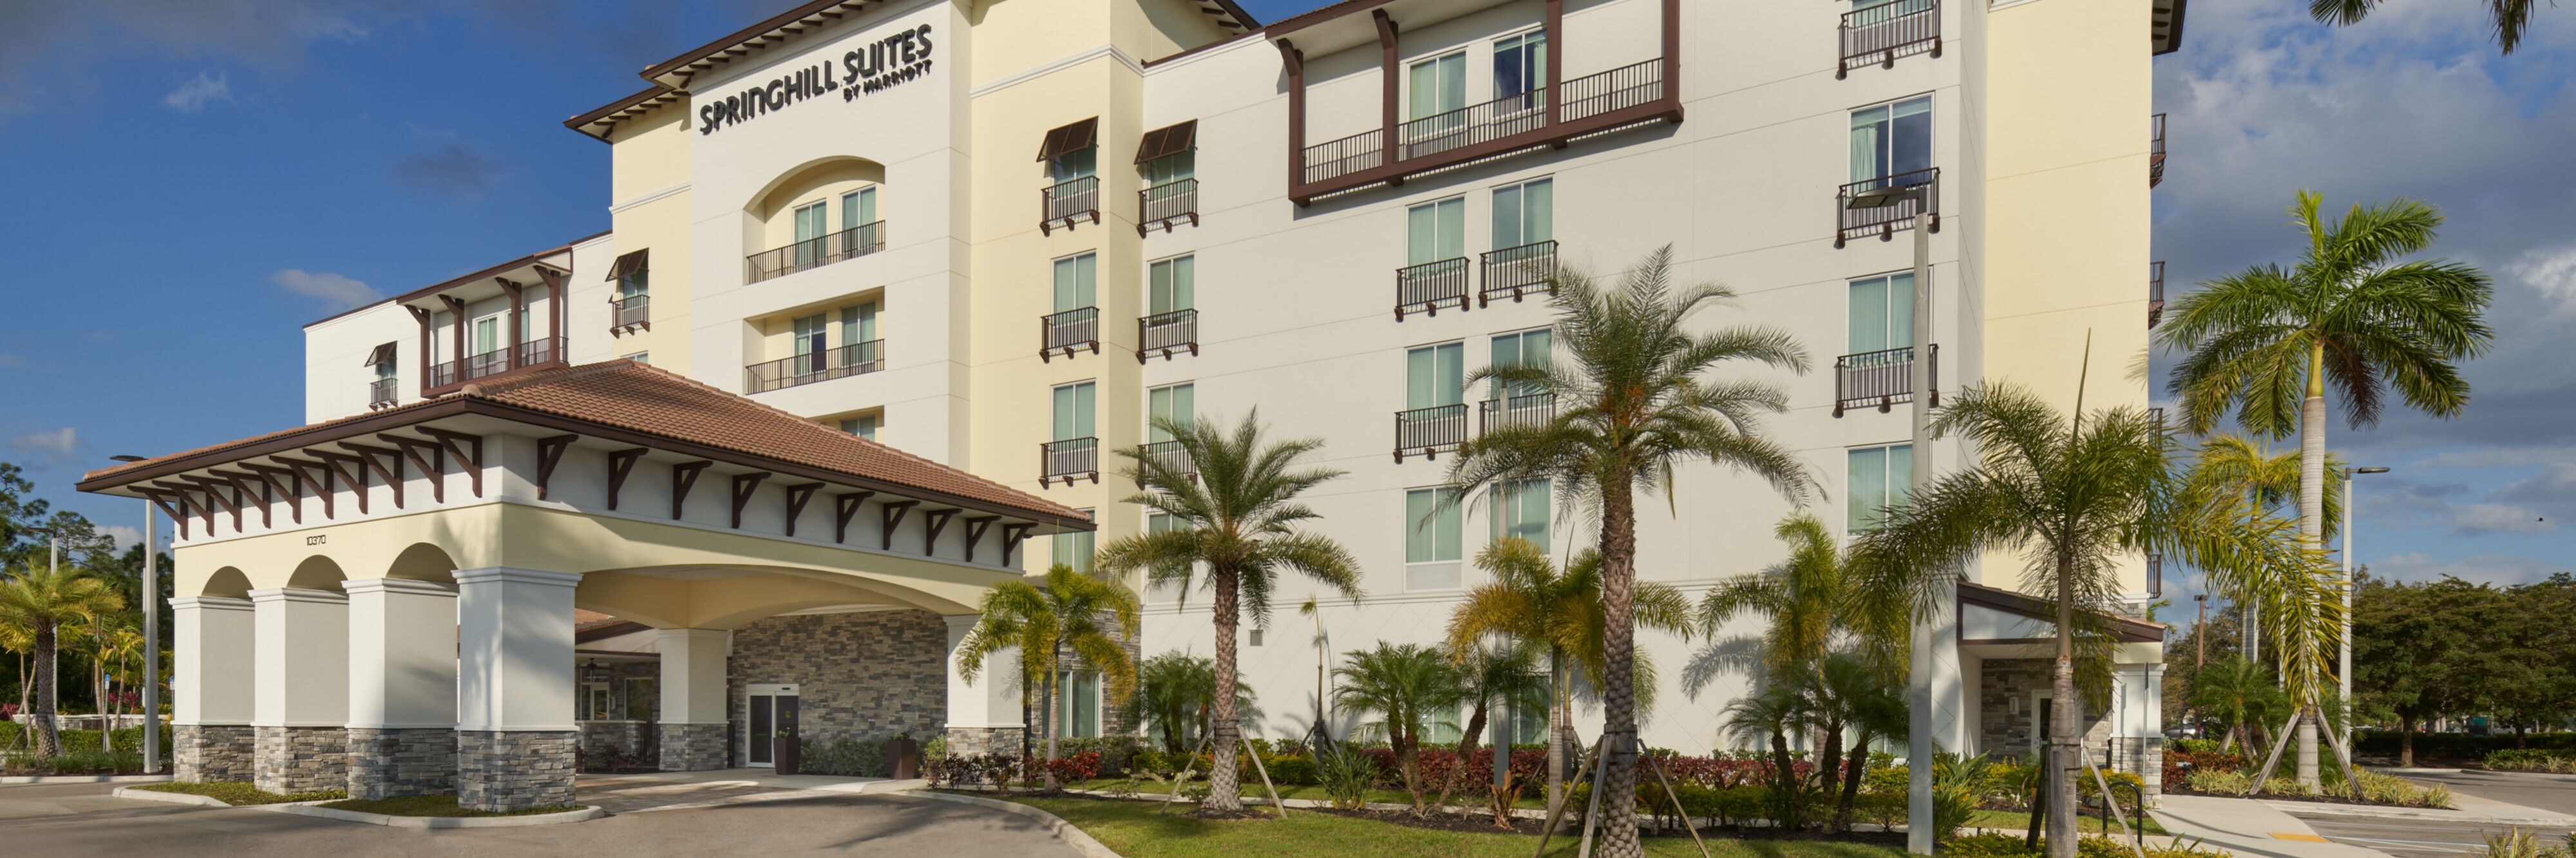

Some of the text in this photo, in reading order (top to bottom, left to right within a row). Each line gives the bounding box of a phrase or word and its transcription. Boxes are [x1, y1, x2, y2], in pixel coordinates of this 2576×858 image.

[699, 24, 933, 135] SPRINGHILL SUITES
[843, 59, 933, 102] BY MARRIOTT
[306, 534, 327, 546] 10370
